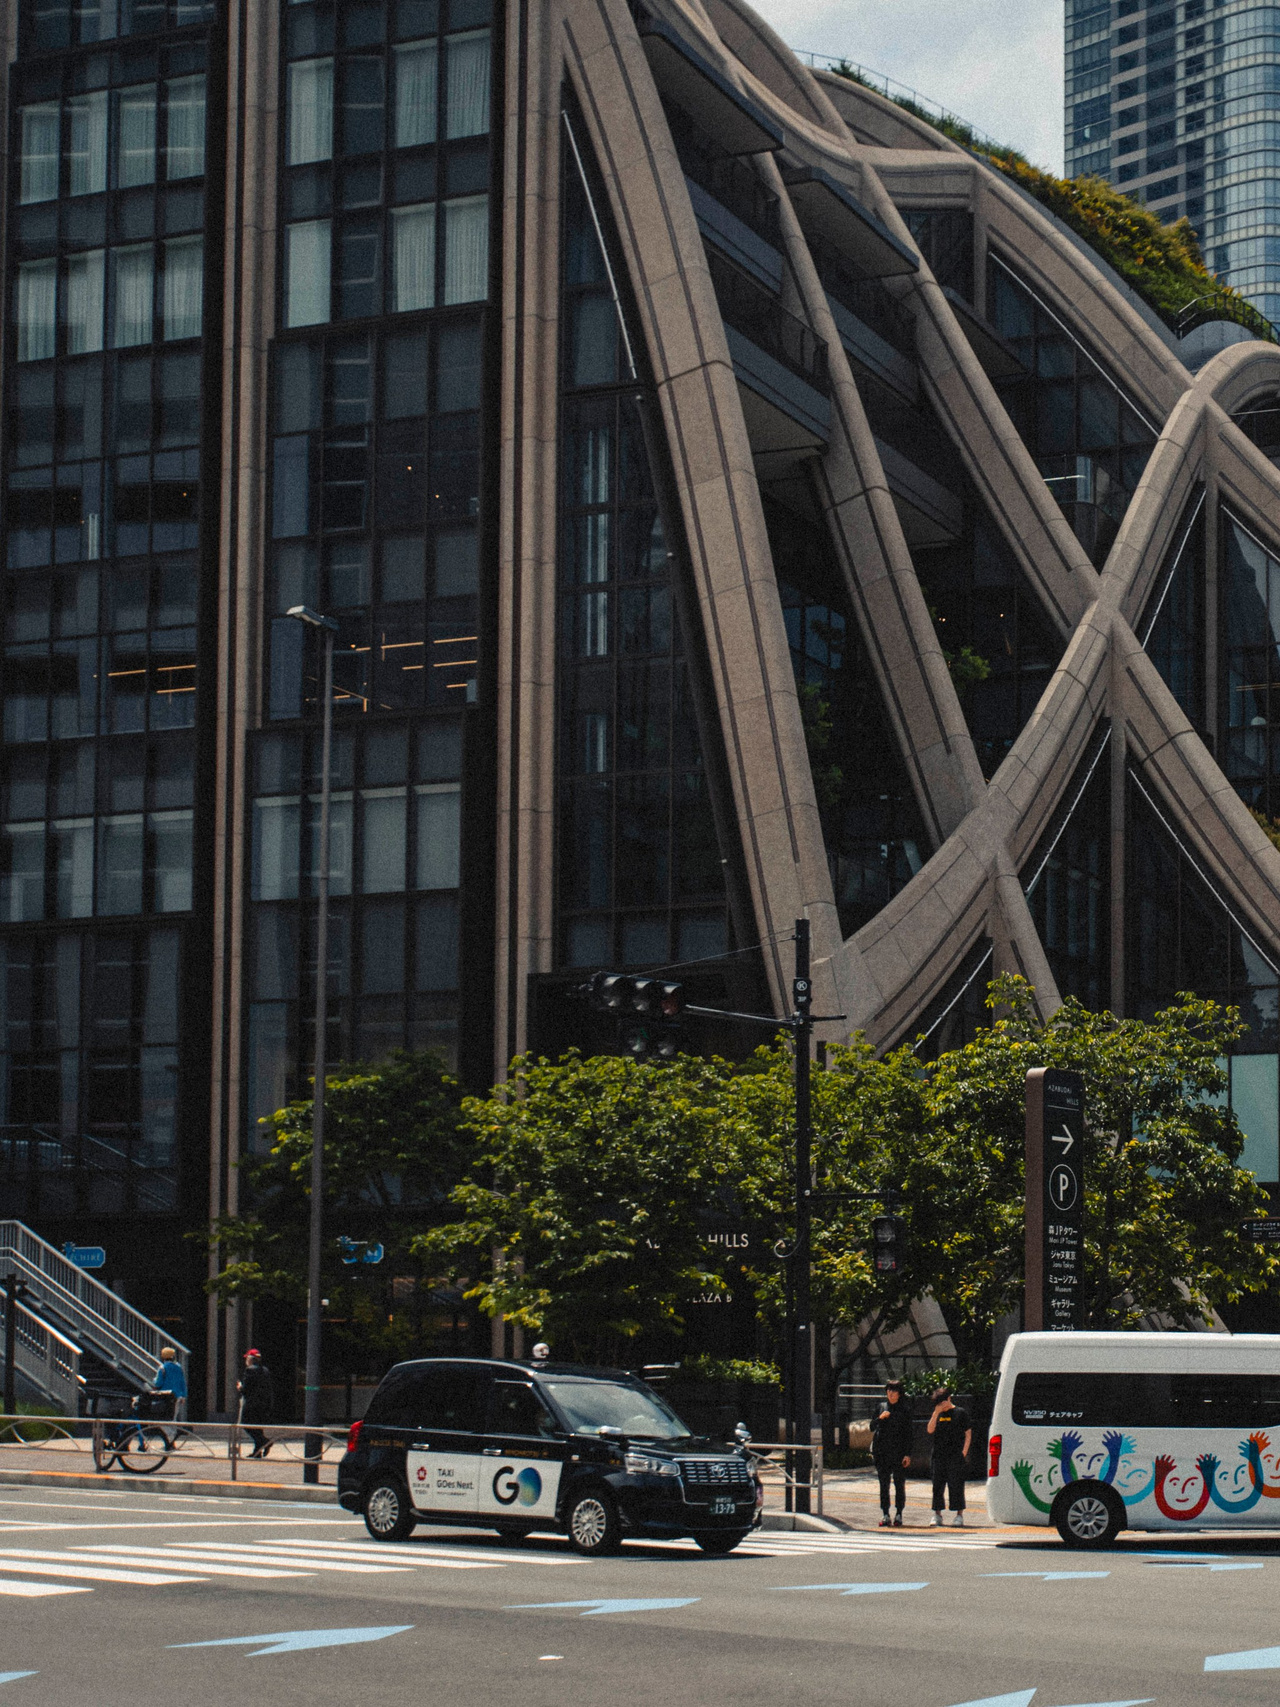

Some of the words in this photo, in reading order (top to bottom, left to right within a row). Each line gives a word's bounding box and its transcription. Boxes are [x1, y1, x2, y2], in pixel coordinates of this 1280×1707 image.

[1066, 1098, 1079, 1106] HILLS
[1060, 1173, 1069, 1201] P
[1050, 1250, 1077, 1260] ジャヌ東京
[1062, 1261, 1075, 1270] Tokyo
[1048, 1274, 1078, 1284] ミュージアム
[1050, 1298, 1075, 1309] ギャラリー
[1054, 1310, 1071, 1319] Gallery
[1050, 1323, 1075, 1331] マーケット
[438, 1468, 454, 1477] TAXI
[436, 1479, 455, 1489] GOes
